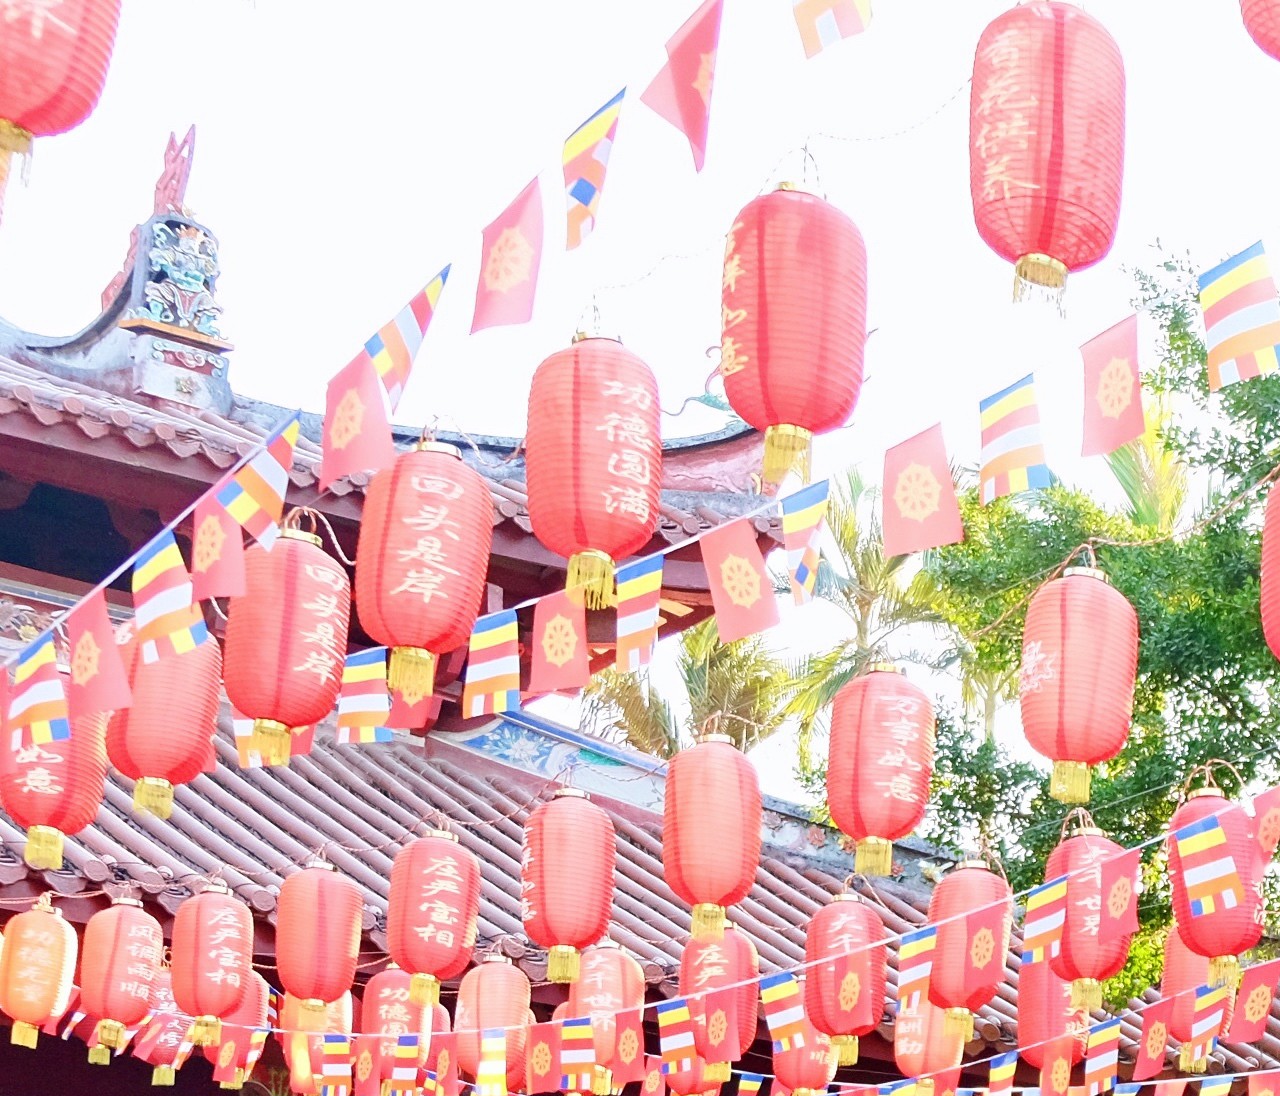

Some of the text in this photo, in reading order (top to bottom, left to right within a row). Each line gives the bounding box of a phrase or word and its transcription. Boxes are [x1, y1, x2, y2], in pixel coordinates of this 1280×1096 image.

[390, 474, 465, 603] 回头是岸
[294, 561, 347, 686] 回头是岸
[874, 694, 922, 804] 万事如意
[206, 907, 241, 989] 庄严宝相
[413, 855, 464, 948] 庄严宝相
[119, 925, 157, 1001] 风调雨顺
